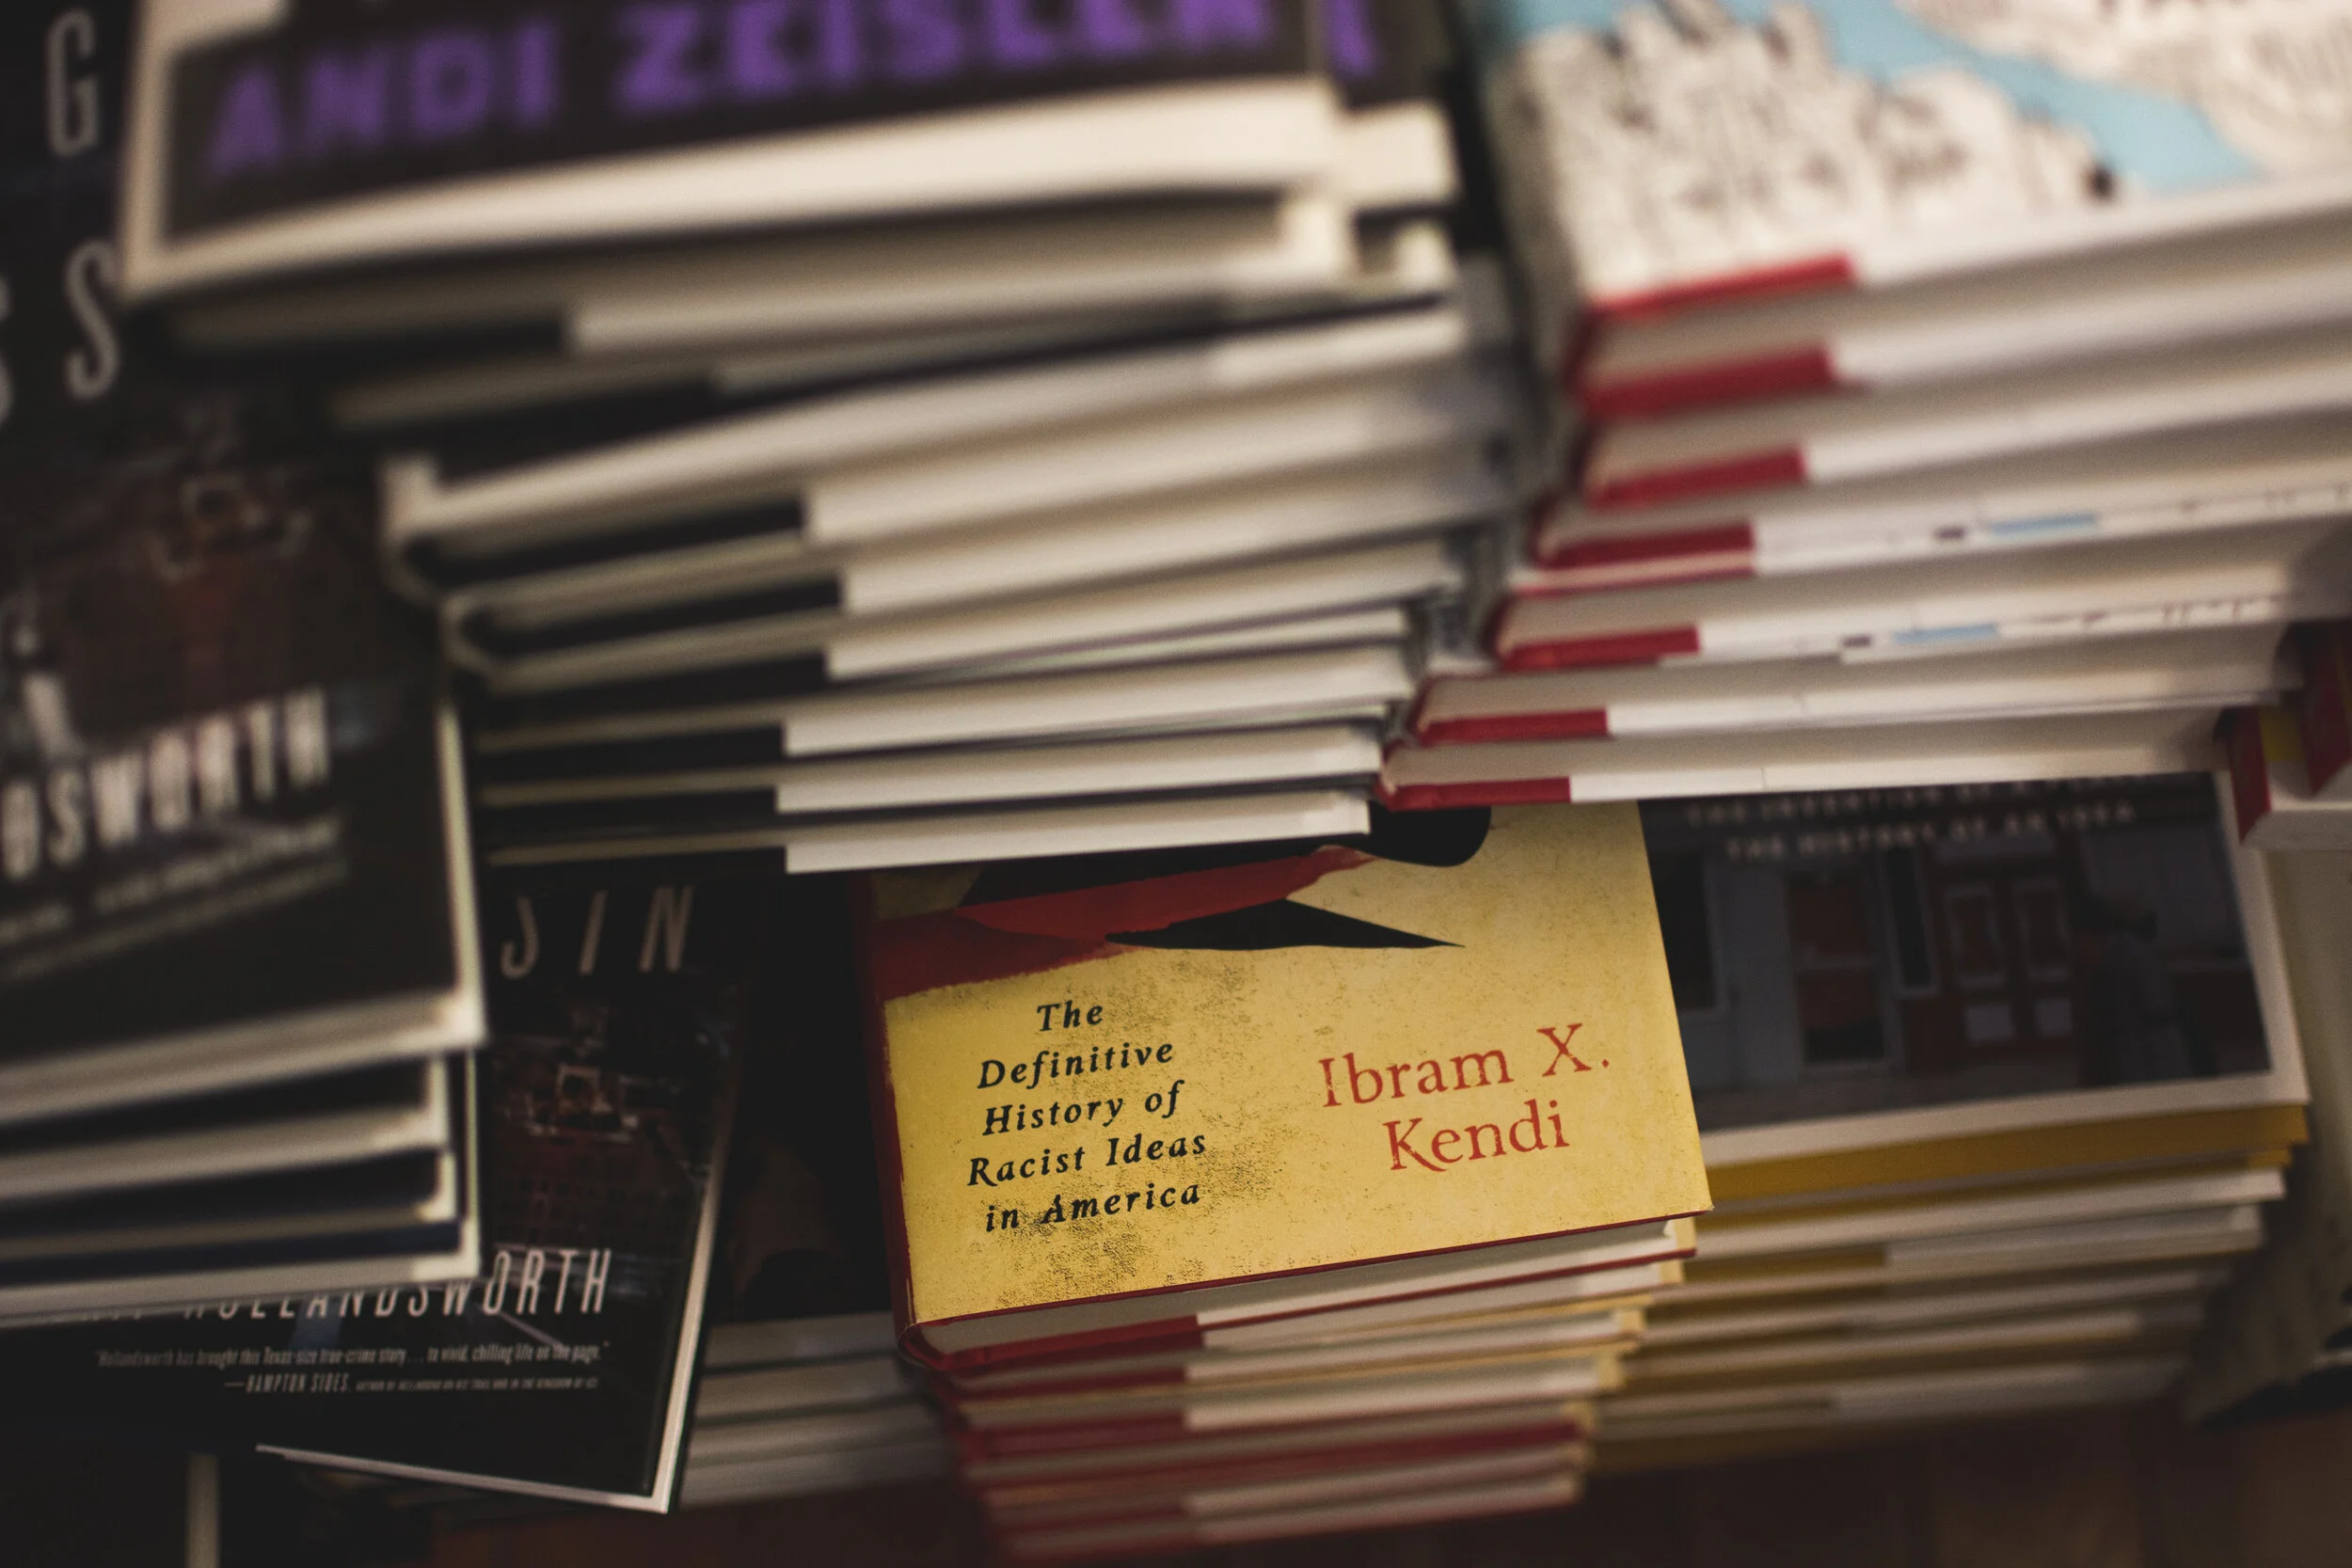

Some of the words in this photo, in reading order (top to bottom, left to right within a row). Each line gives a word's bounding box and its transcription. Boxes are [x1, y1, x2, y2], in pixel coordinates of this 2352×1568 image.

[1037, 1000, 1104, 1032] The
[977, 1042, 1173, 1089] Definitive
[1318, 1049, 1514, 1107] Ibram
[1536, 1022, 1610, 1077] X.
[982, 1098, 1123, 1136] History
[1144, 1080, 1184, 1118] of
[967, 1147, 1085, 1187] Racist
[1105, 1133, 1205, 1166] Ideas
[1382, 1099, 1570, 1173] Kendi
[985, 1205, 1020, 1232] in
[1039, 1182, 1200, 1225] America
